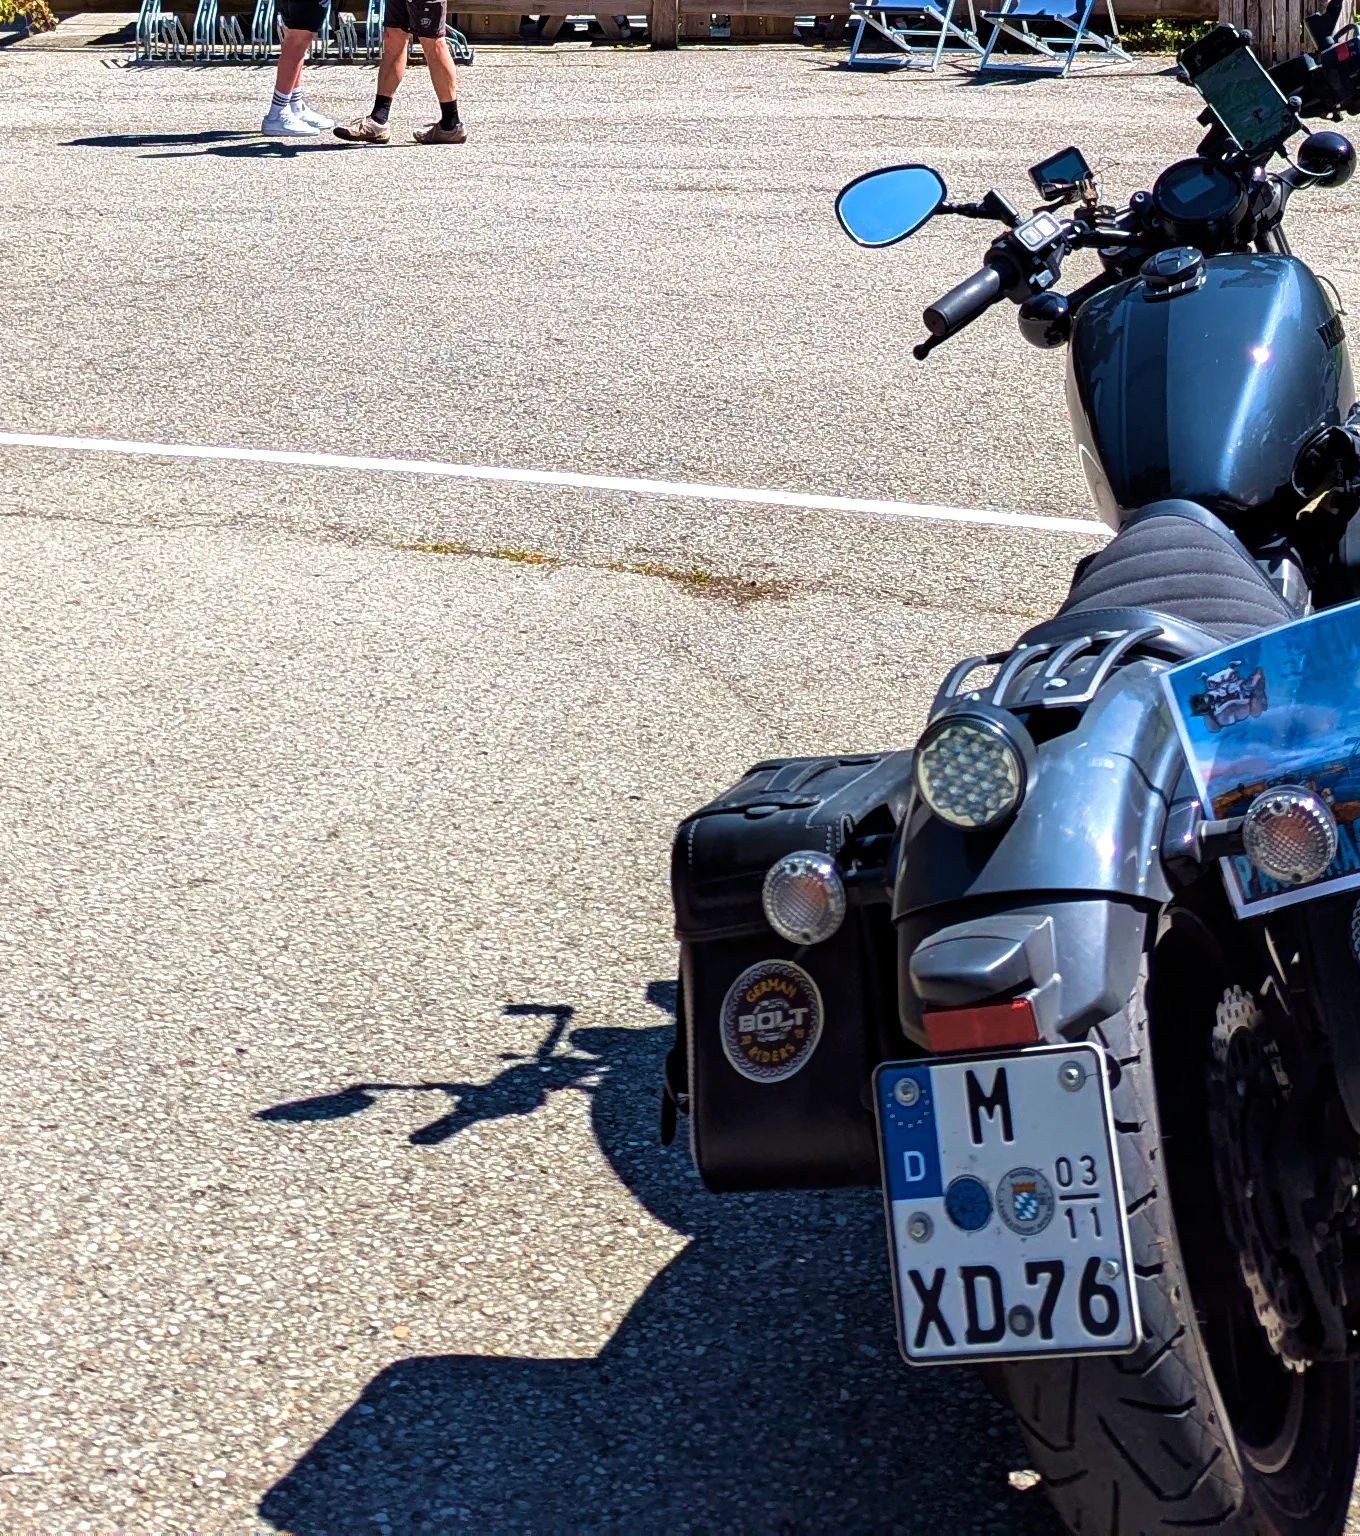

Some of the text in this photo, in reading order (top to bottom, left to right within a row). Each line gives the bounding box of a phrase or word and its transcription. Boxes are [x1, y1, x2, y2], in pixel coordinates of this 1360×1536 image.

[746, 978, 798, 1003] GERMAN
[738, 1007, 809, 1032] BOLT
[748, 1043, 796, 1063] RIDERS
[964, 1066, 1015, 1145] M
[903, 1150, 927, 1182] D
[1054, 1154, 1097, 1188] 03
[1064, 1206, 1103, 1240] 11
[907, 1256, 1121, 1350] XD 76
